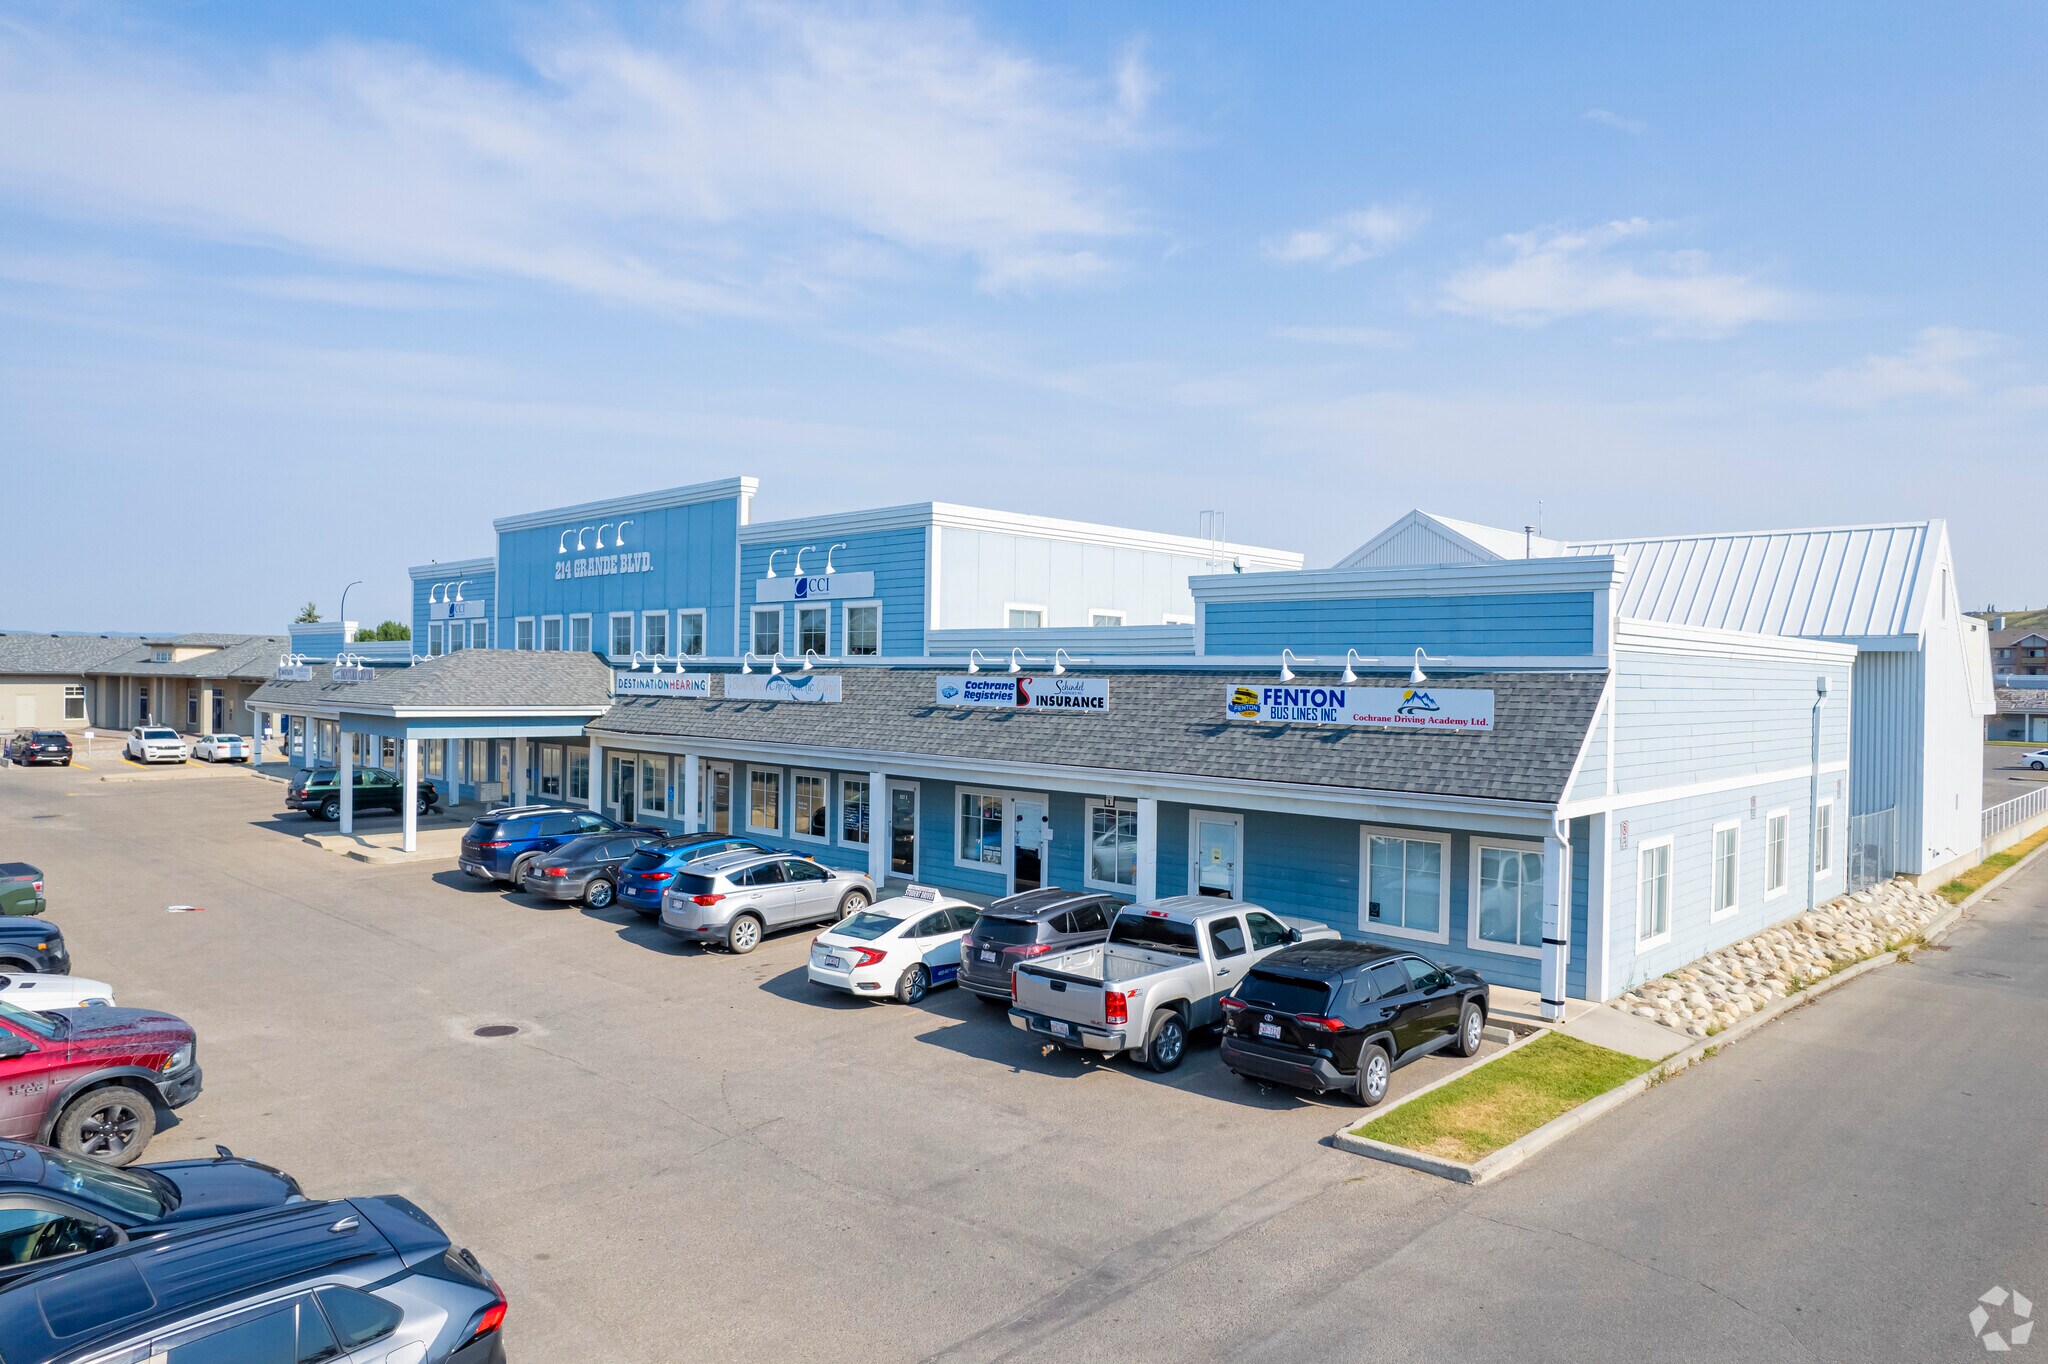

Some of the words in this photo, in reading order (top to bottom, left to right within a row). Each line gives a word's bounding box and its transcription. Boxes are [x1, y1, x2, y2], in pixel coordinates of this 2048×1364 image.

[554, 561, 572, 580] 214
[574, 554, 618, 578] GRANDE
[620, 551, 654, 574] BLVD.
[808, 577, 830, 593] CCI
[965, 681, 1015, 691] Cochrane
[1054, 679, 1085, 695] Schindel
[963, 690, 1014, 702] Registries
[1036, 695, 1104, 709] INSURANCE
[1263, 688, 1346, 708] FENTON
[1233, 704, 1259, 712] FENTON
[1270, 706, 1289, 720] BUS
[1291, 707, 1318, 721] LINES
[1320, 708, 1337, 722] INC
[1352, 713, 1392, 723] Cochrane
[1394, 715, 1426, 725] Driving
[1428, 716, 1468, 727] Academy
[1471, 717, 1489, 727] Ltd.
[10, 1080, 43, 1090] RAM
